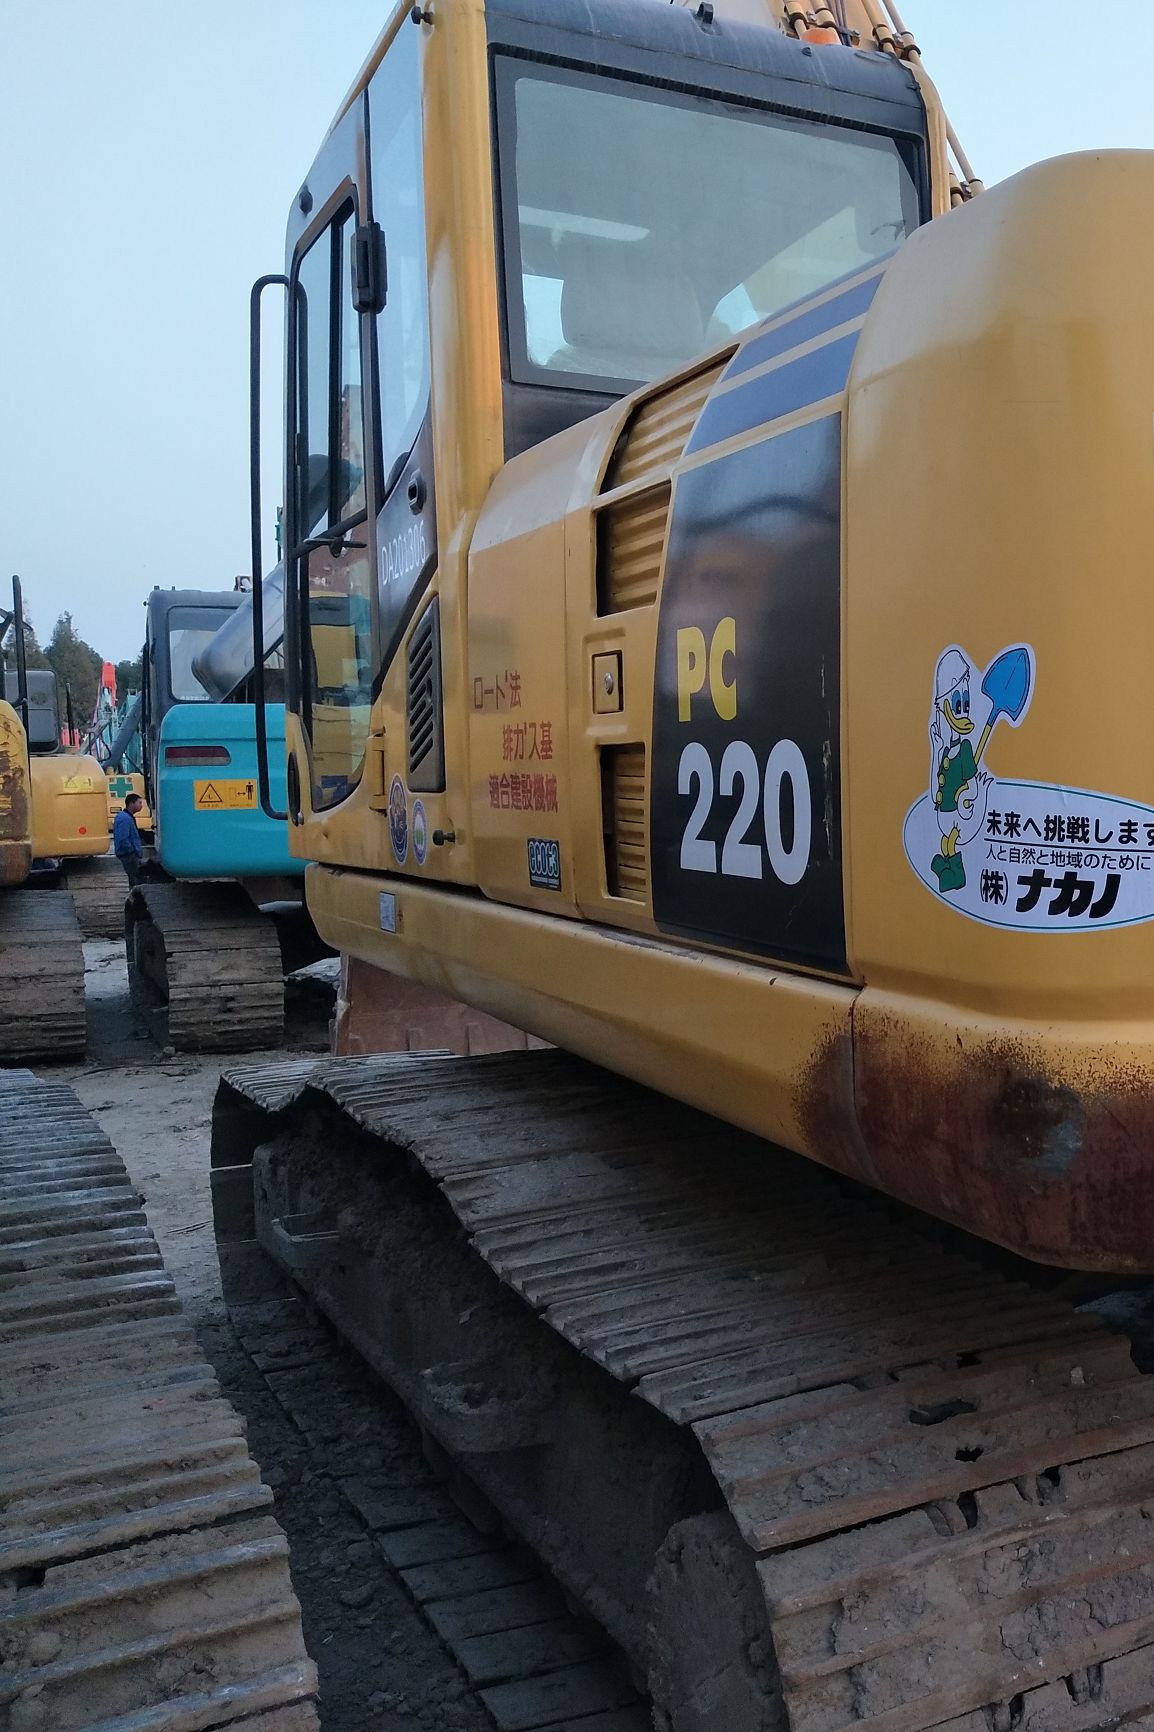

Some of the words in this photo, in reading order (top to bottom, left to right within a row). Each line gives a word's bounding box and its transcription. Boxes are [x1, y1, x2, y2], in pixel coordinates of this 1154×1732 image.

[381, 519, 426, 586] DA201306
[676, 617, 737, 722] PC
[677, 739, 812, 885] 220
[986, 843, 1152, 871] 人と自然と地域のために
